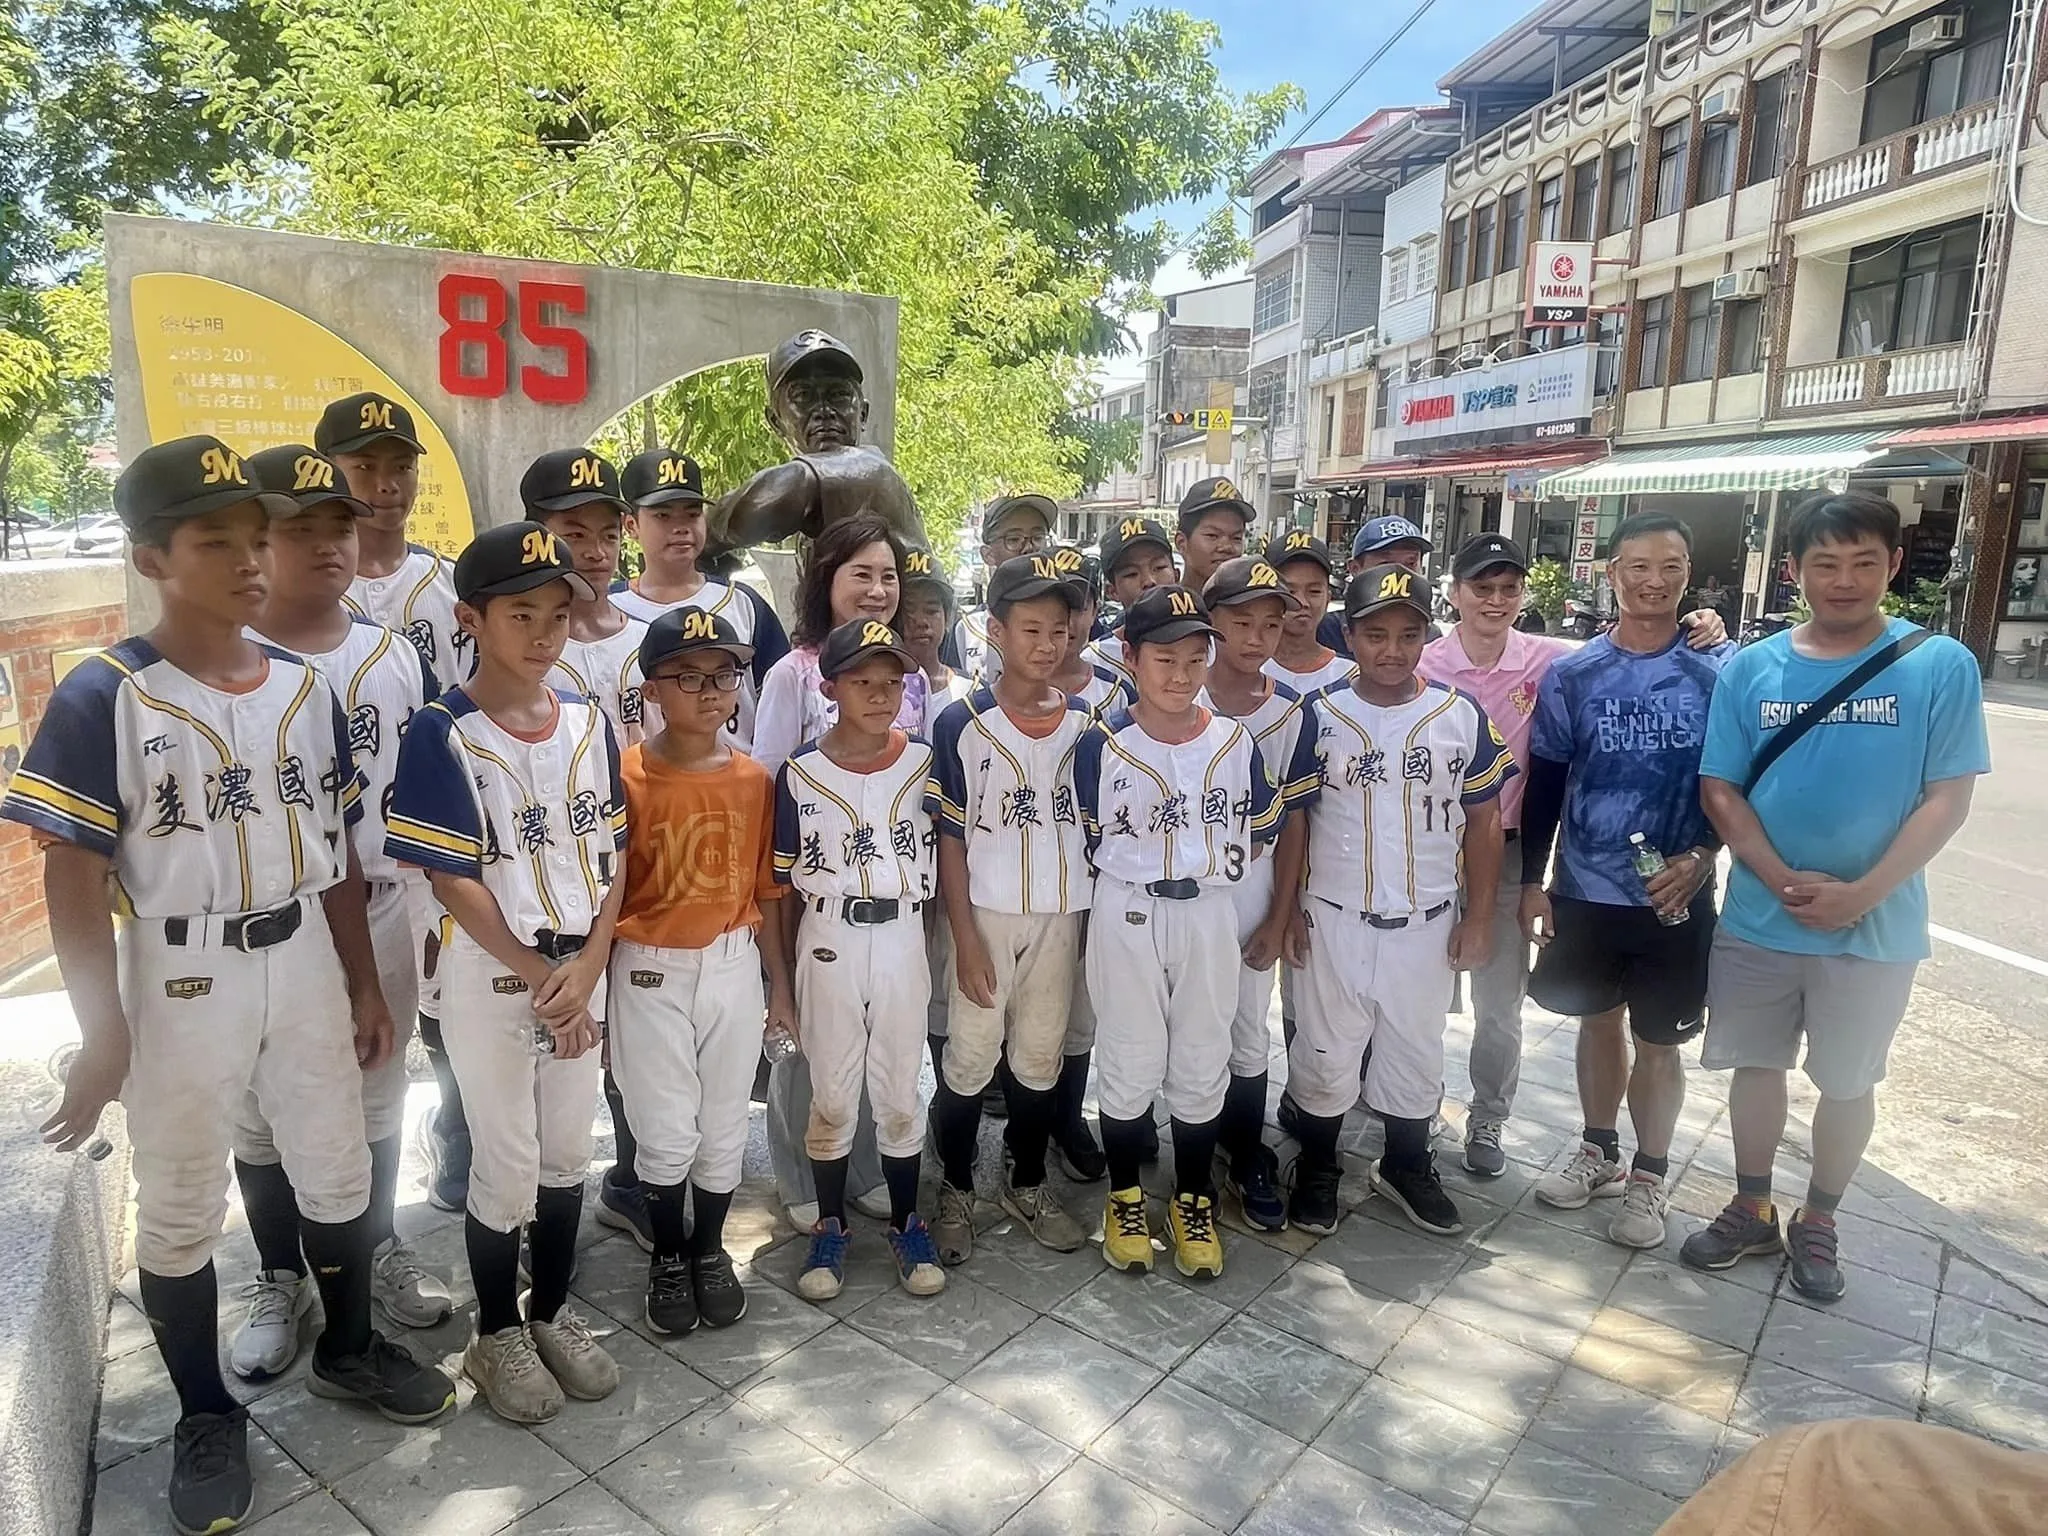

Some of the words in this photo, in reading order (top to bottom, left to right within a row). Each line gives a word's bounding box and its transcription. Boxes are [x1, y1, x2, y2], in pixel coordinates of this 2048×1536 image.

[1540, 284, 1584, 298] YAMAHA
[1547, 309, 1574, 321] YSP
[438, 273, 589, 405] 85
[361, 401, 396, 430] M
[200, 447, 248, 485] M
[294, 455, 334, 489] M
[570, 456, 605, 488] M
[657, 456, 689, 485] M
[1211, 479, 1237, 500] M
[1120, 518, 1147, 541] M
[1284, 532, 1312, 552] M
[521, 530, 560, 566] M
[1055, 549, 1082, 573] M
[905, 551, 931, 575] M
[1031, 556, 1059, 580] M
[1247, 562, 1279, 588] M
[1378, 572, 1412, 599] M
[1167, 591, 1198, 616] M
[682, 611, 719, 641] M
[859, 619, 894, 647] M
[1760, 701, 1791, 730] HSU
[1852, 695, 1897, 725] MING
